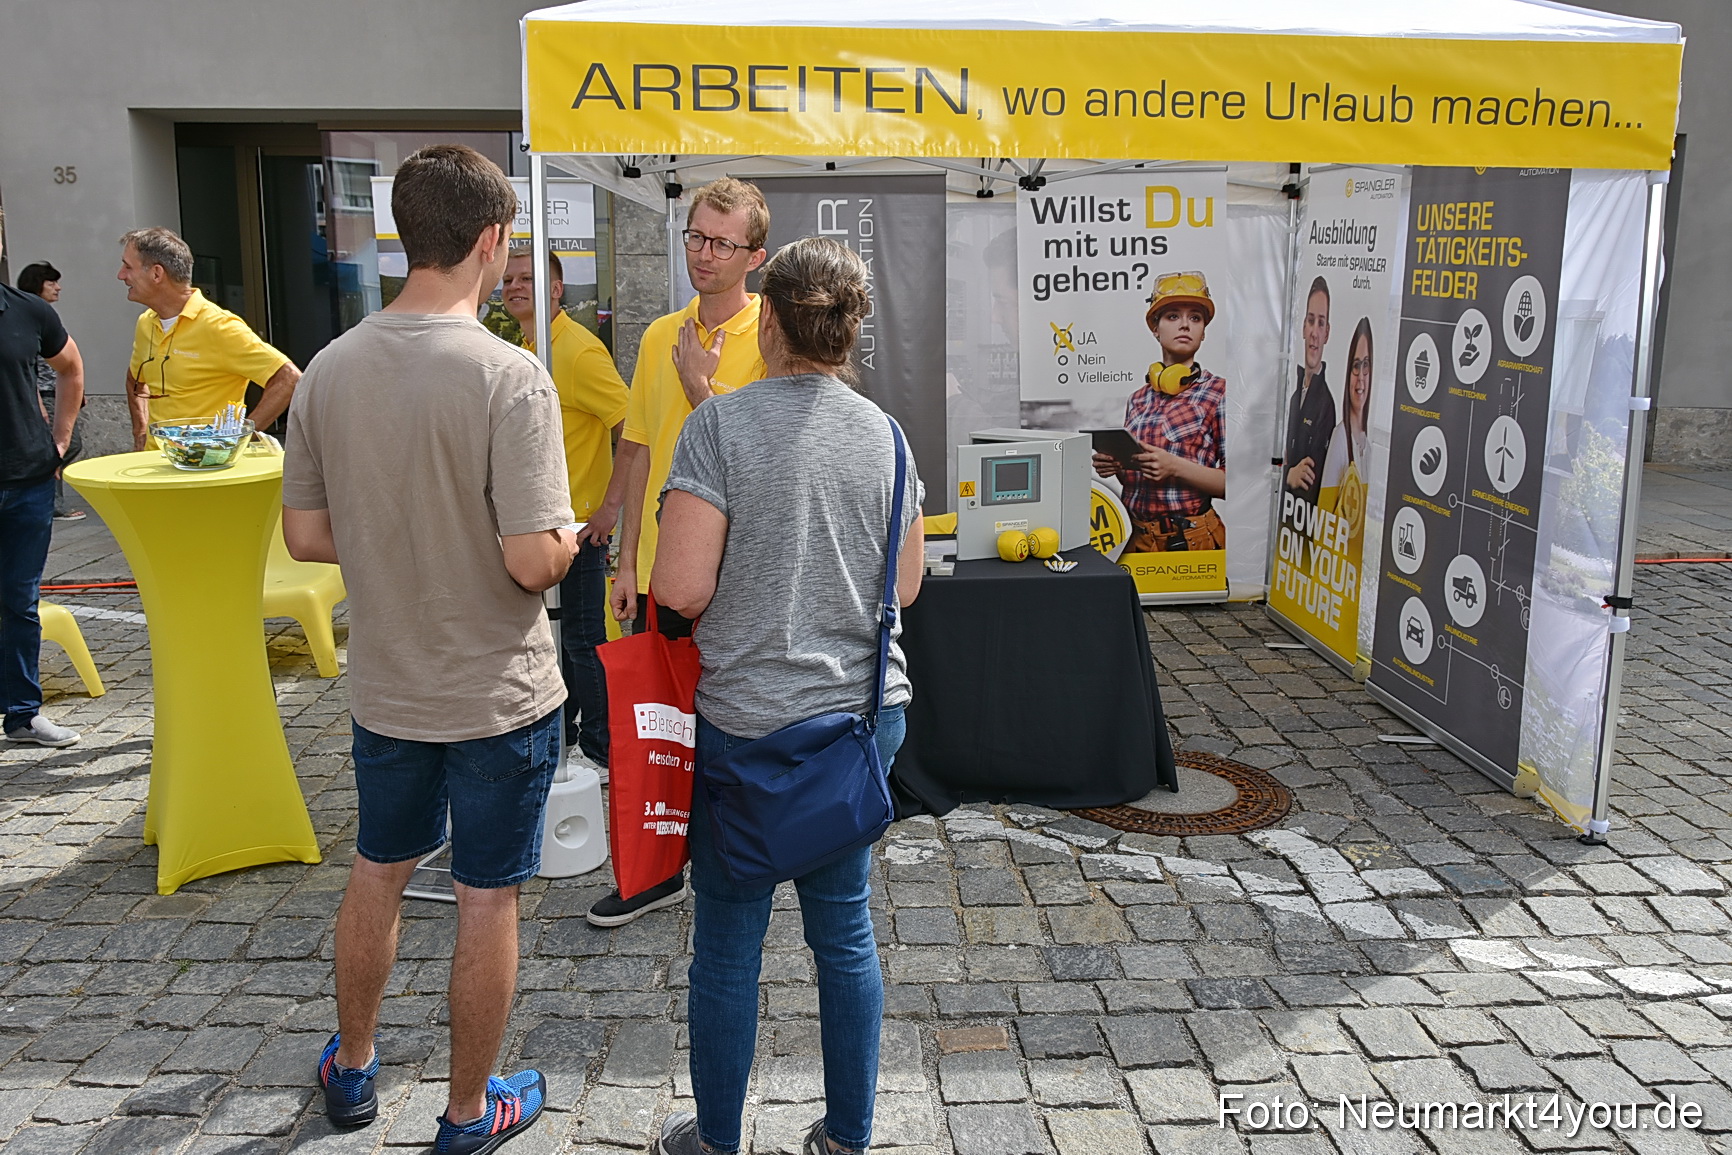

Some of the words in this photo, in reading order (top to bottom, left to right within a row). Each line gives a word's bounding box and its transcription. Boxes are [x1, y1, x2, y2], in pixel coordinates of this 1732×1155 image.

[571, 62, 984, 120] ARBEITEN,
[1002, 86, 1066, 117] wo
[1084, 79, 1246, 120] andere
[1264, 81, 1414, 124] Urlaub
[1431, 87, 1644, 129] machen...
[54, 166, 77, 184] 35
[1354, 178, 1395, 193] SPANGLER
[1030, 195, 1132, 224] Willst
[1145, 185, 1214, 229] Du
[1417, 201, 1495, 231] UNSERE
[1044, 230, 1098, 259] mit
[1110, 235, 1168, 257] uns
[1309, 219, 1377, 252] Ausbildung
[1415, 230, 1528, 268] TÄTIGKEITS-
[1316, 253, 1336, 267] Starte
[1337, 254, 1349, 267] mit
[1349, 256, 1387, 272] SPANGLER
[1032, 262, 1149, 301] gehen?
[1352, 275, 1371, 290] durch.
[1411, 269, 1479, 301] FELDER
[1077, 331, 1097, 346] JA
[1077, 353, 1106, 365] Nein
[1077, 371, 1133, 383] Vielleicht
[1282, 491, 1350, 556] POWER
[1135, 564, 1217, 576] SPANGLER
[1279, 526, 1304, 569] ON
[1308, 540, 1357, 602] YOUR
[1276, 560, 1343, 632] FUTURE
